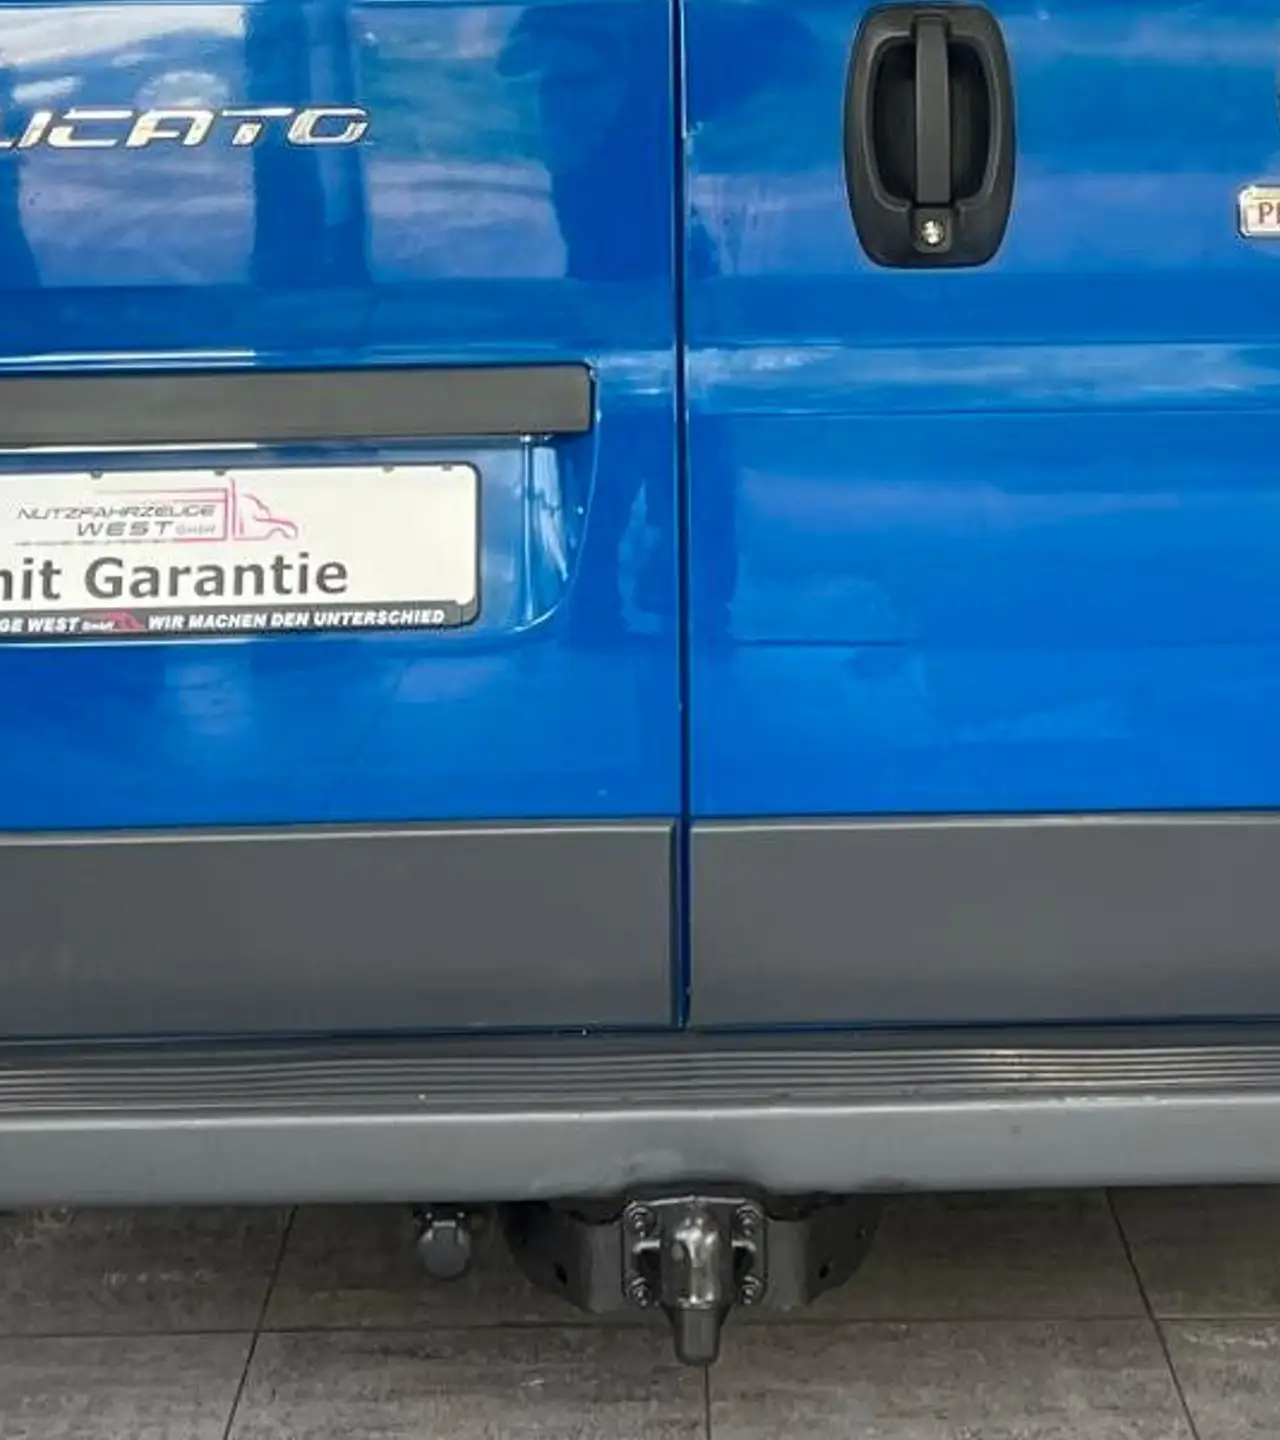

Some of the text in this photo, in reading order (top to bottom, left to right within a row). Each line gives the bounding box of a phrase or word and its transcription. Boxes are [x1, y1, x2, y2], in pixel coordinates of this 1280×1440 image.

[76, 520, 174, 537] WEST
[84, 552, 348, 600] Garantie
[27, 615, 81, 633] WEST
[148, 613, 184, 631] WIR
[187, 612, 269, 630] MACHEN
[270, 610, 312, 627] DEN
[314, 607, 446, 627] UNTERSCHIED
